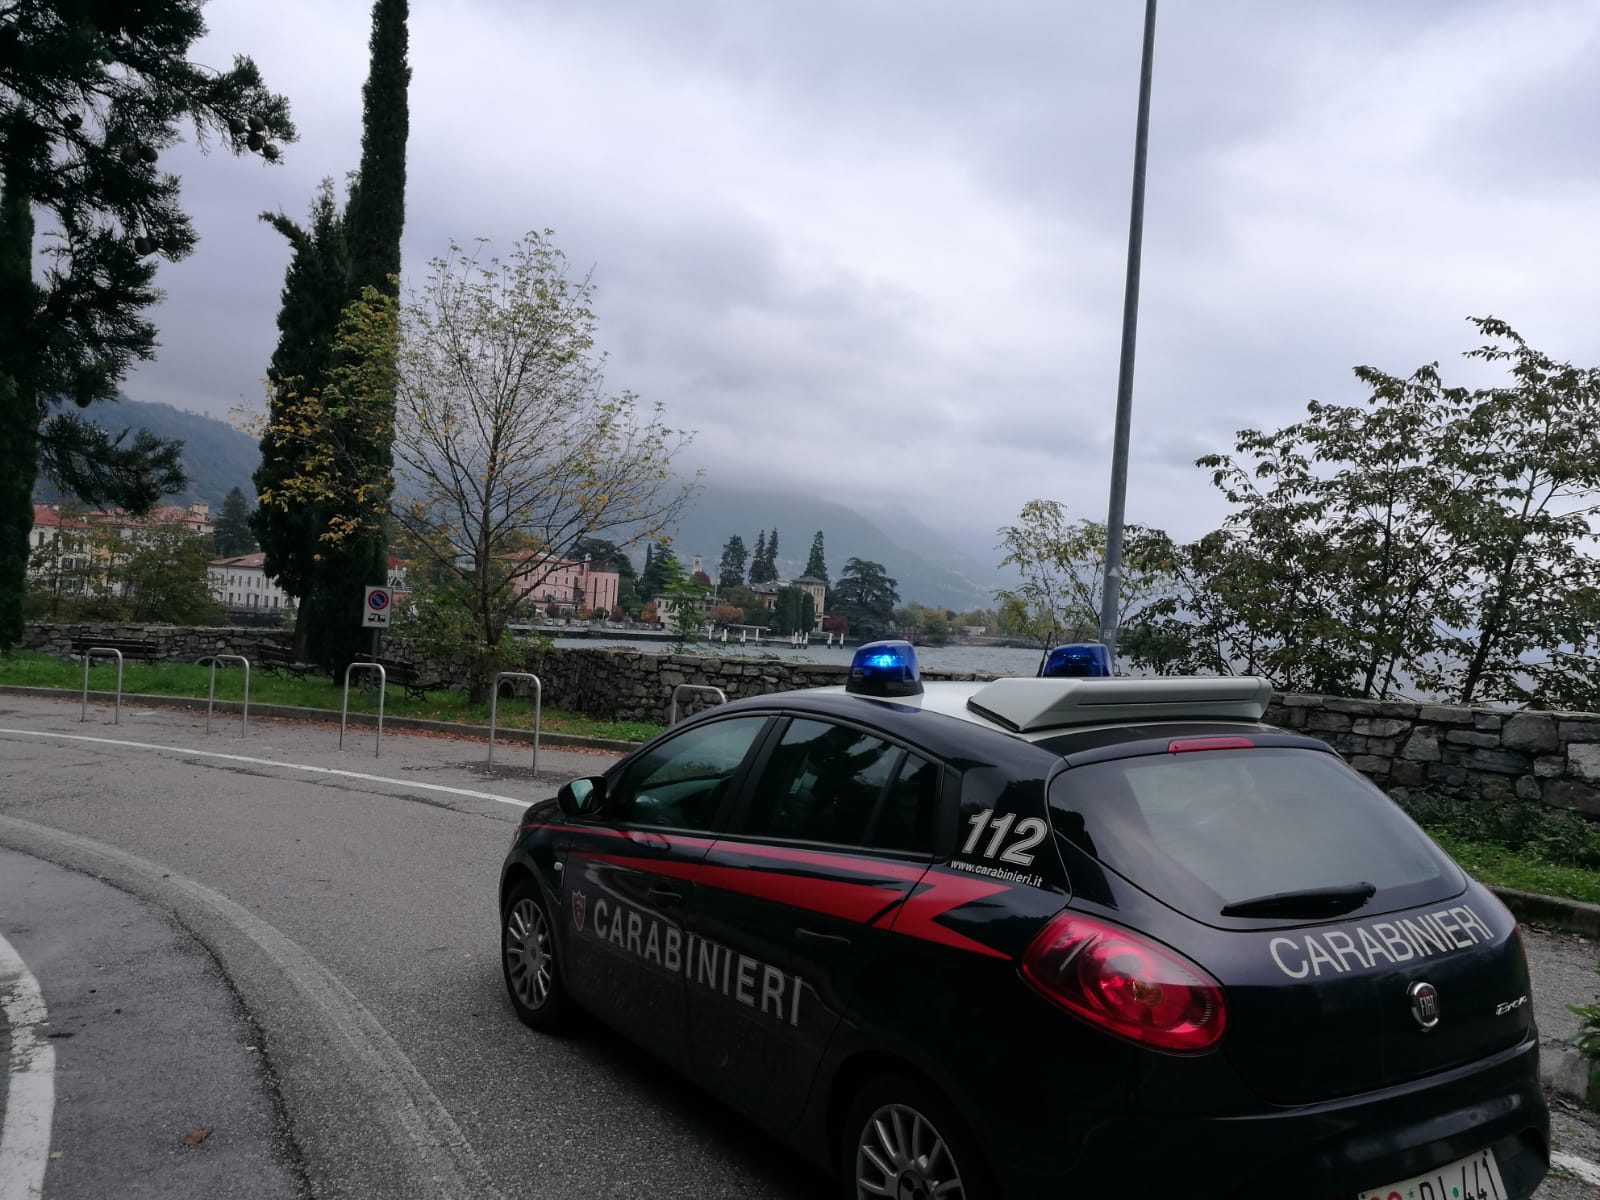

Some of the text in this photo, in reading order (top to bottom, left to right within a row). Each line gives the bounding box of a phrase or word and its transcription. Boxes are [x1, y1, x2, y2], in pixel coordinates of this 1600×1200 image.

[962, 809, 1047, 867] 112
[950, 859, 1043, 887] www.carabinieri.it
[593, 898, 802, 1026] CARABINIERI
[1269, 904, 1495, 979] CARABINIERI
[1419, 994, 1435, 1017] FIAT
